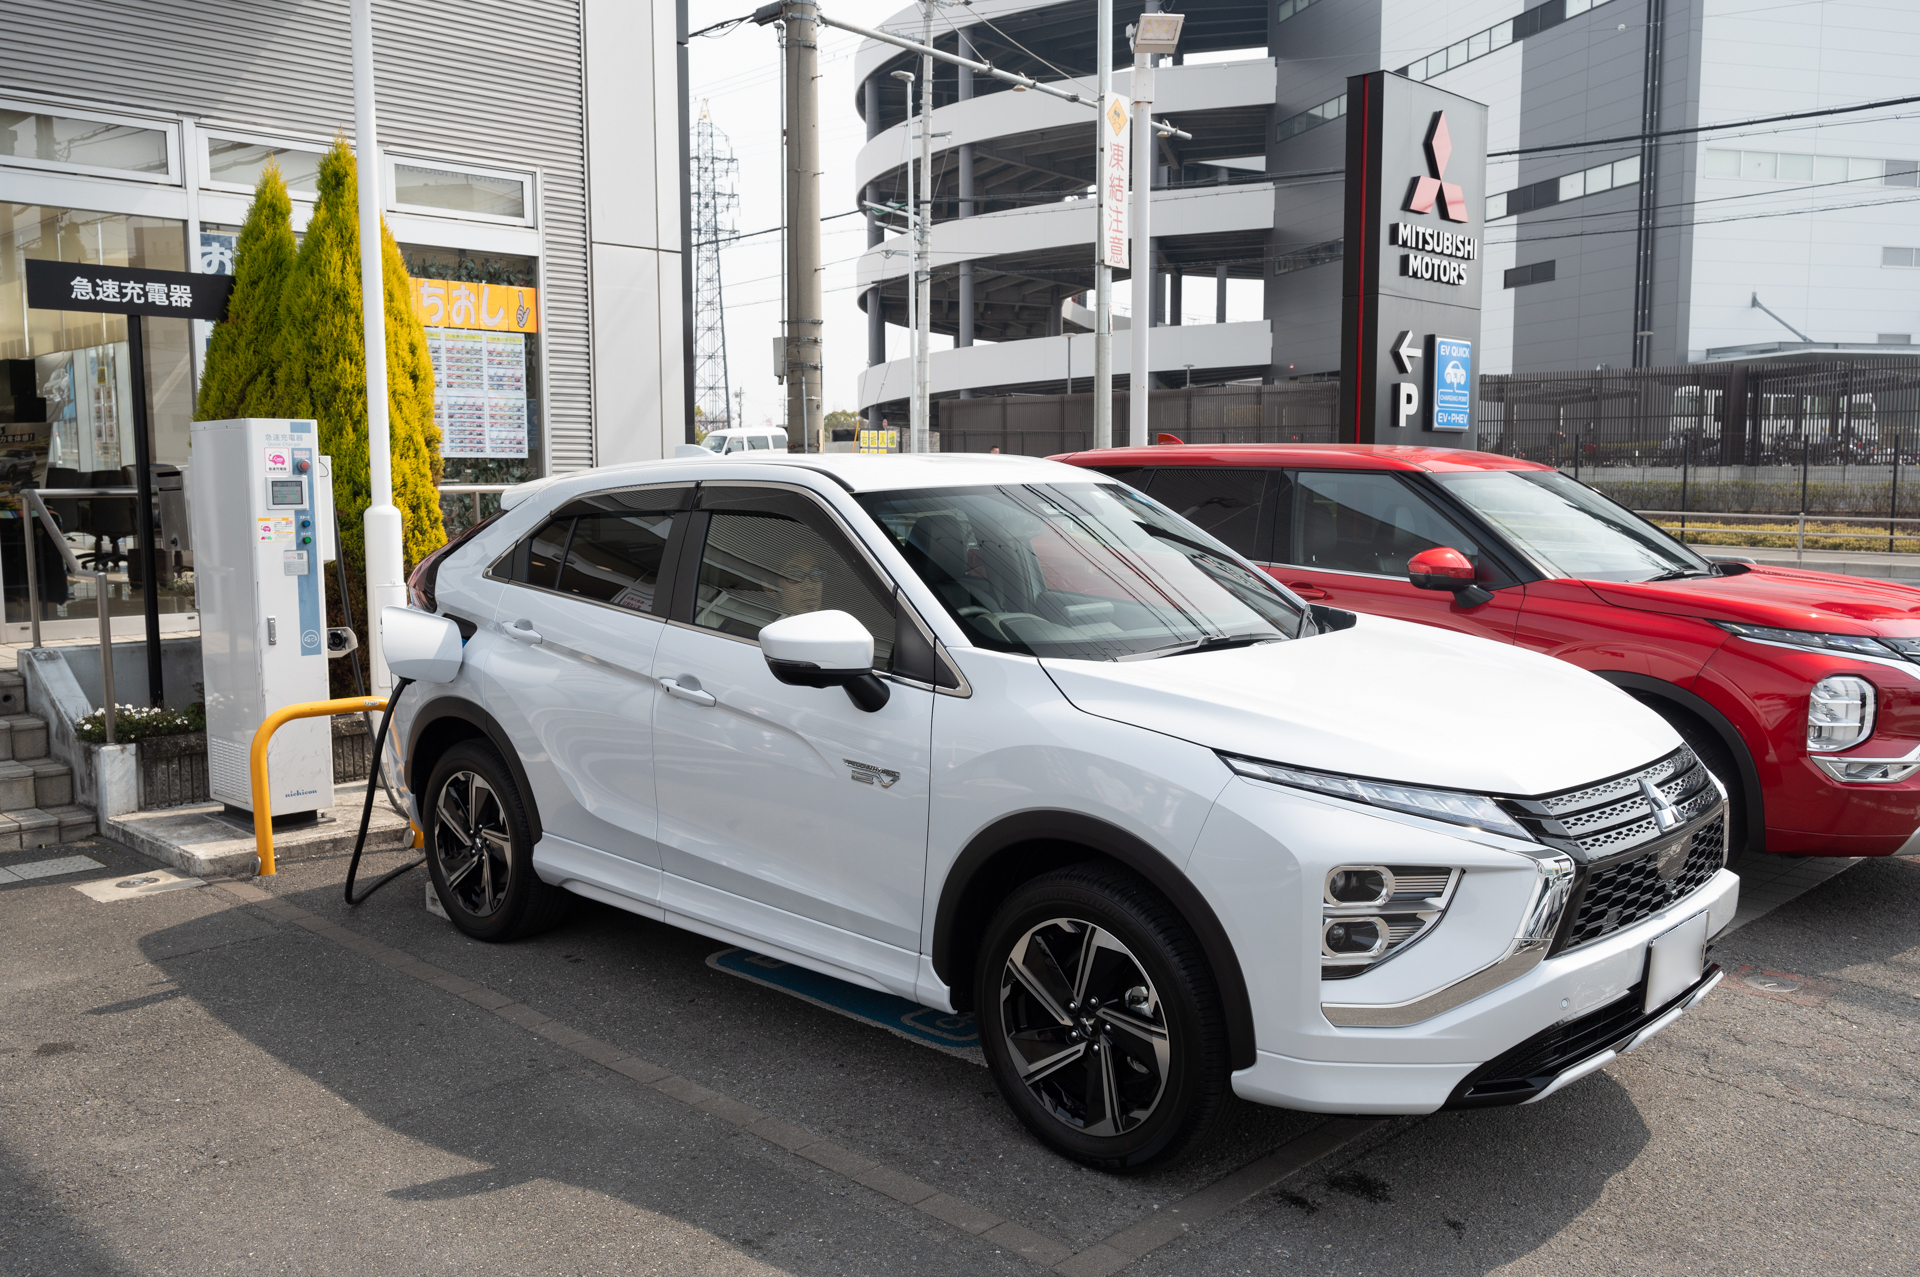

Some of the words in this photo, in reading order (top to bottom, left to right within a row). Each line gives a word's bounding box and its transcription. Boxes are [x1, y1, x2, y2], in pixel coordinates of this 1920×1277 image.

[1108, 141, 1125, 265] 凍結注意
[1398, 221, 1478, 260] MITSUBISHI
[1408, 253, 1467, 286] MOTORS
[70, 276, 193, 308] 急速充電器
[409, 280, 505, 328] ちおし
[1440, 344, 1451, 356] EV
[1451, 346, 1470, 358] QUICK
[1399, 382, 1419, 427] P
[265, 433, 303, 442] 急速充電器
[285, 789, 318, 798] nichicon
